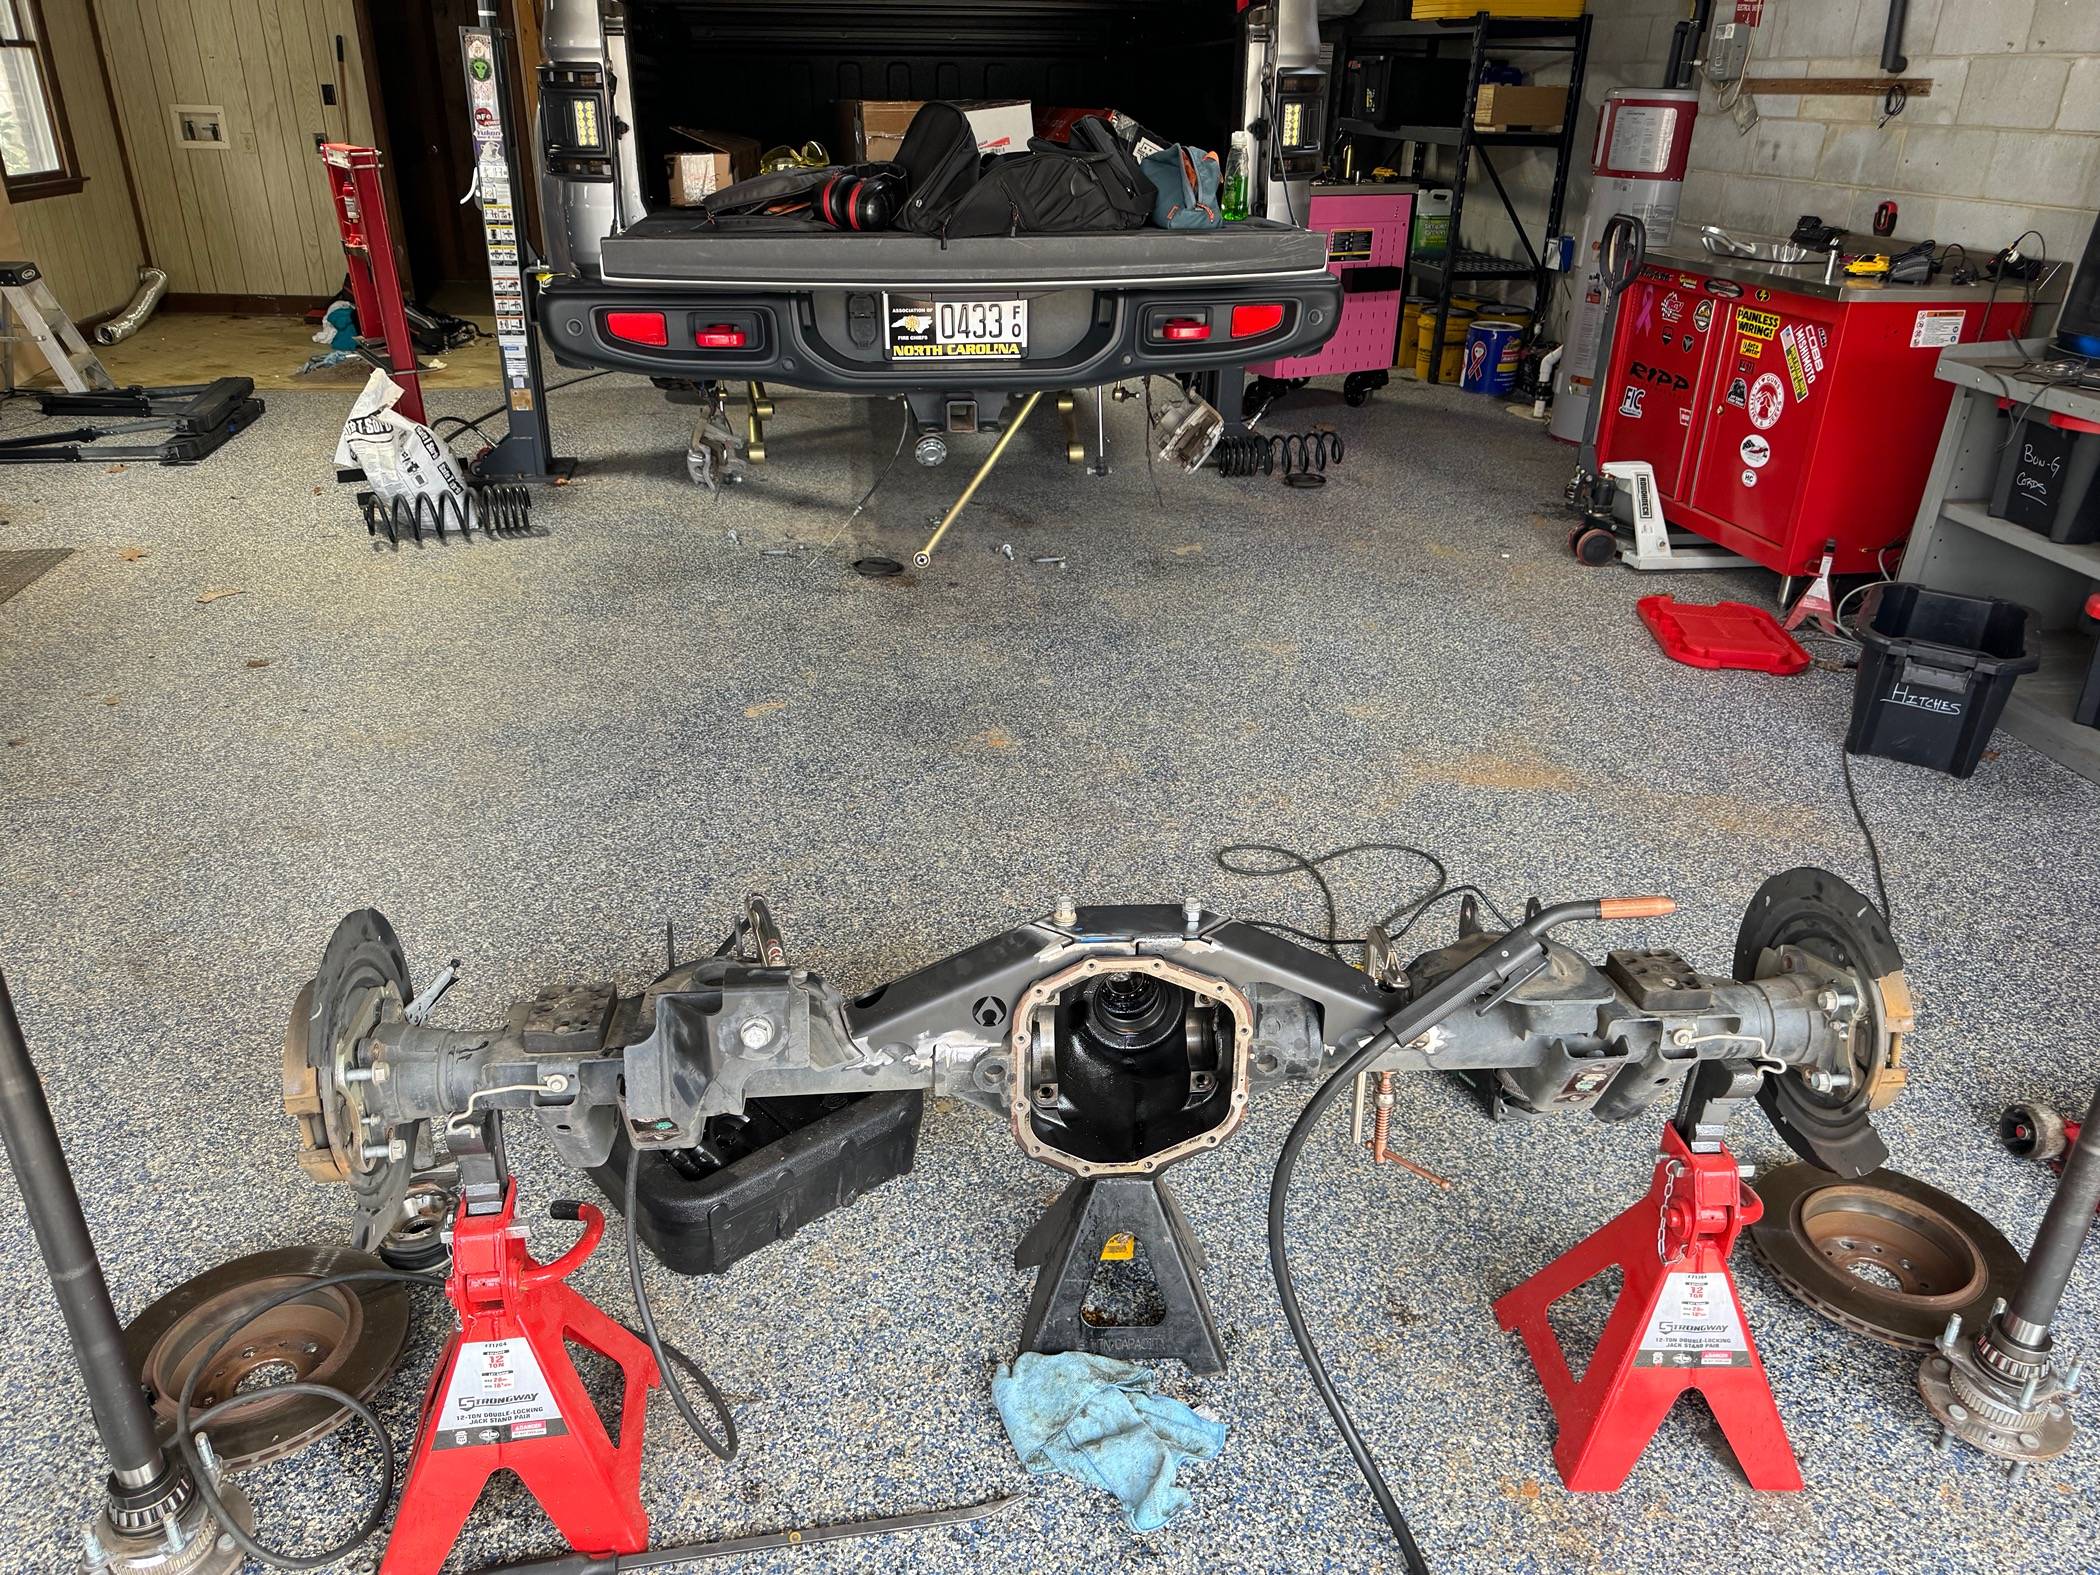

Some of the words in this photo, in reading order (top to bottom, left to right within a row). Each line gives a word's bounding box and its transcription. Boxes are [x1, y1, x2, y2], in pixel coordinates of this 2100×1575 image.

[941, 303, 1003, 339] 0433
[1737, 308, 1780, 328] PAINLESS
[1738, 321, 1773, 338] WIRING!
[893, 344, 943, 356] NORTH
[946, 343, 1020, 355] CAROLINA
[1795, 328, 1816, 384] MISHIMOTO
[1805, 324, 1824, 372] COBB
[1623, 387, 1645, 410] FIC
[1891, 682, 1962, 715] HITCHES
[1690, 1286, 1704, 1294] 12
[1658, 1321, 1729, 1335] STRONGWAY
[488, 1355, 504, 1363] 12
[458, 1392, 539, 1412] STRONGWAY
[456, 1413, 482, 1421] 12-TON
[483, 1406, 544, 1418] DOUBLE-LOCKING
[489, 1416, 513, 1424] STAND
